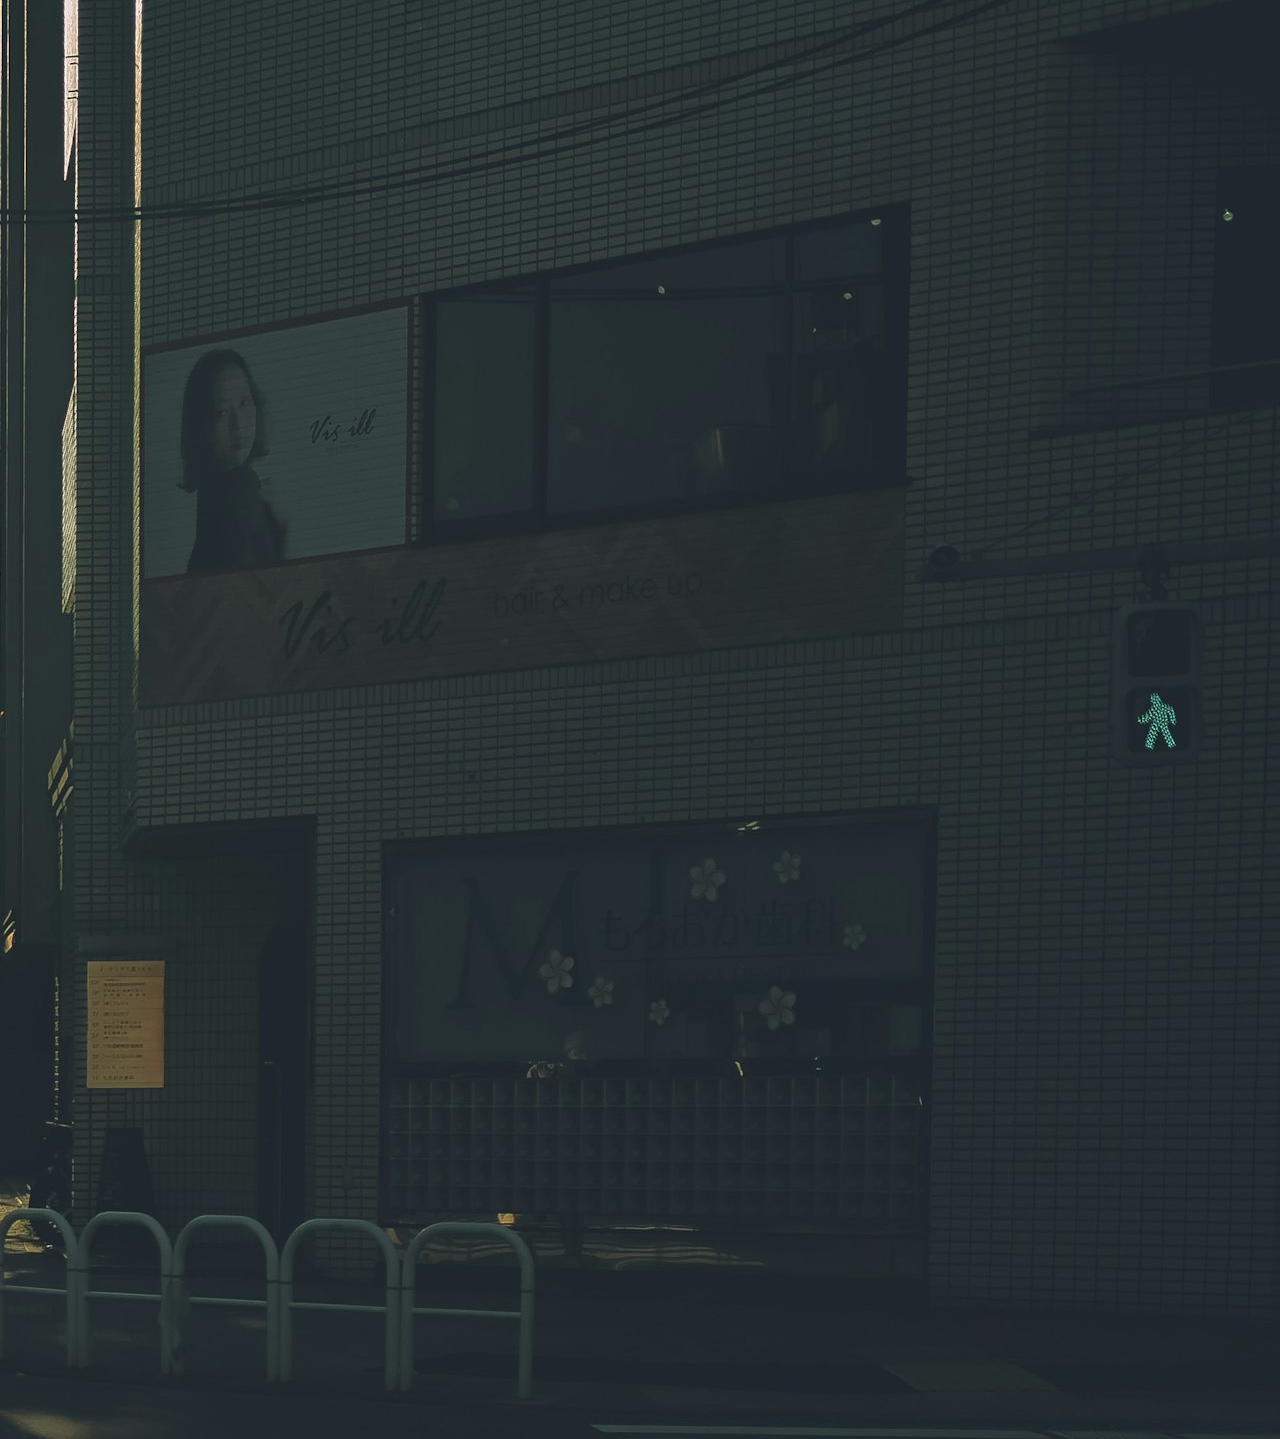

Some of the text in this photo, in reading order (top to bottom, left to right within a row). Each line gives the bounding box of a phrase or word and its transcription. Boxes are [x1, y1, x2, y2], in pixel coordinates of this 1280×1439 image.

[310, 414, 341, 444] Vis
[278, 588, 358, 658] Vis
[493, 588, 542, 618] hair
[551, 583, 570, 611] &
[578, 573, 657, 607] make
[666, 571, 704, 600] up
[446, 867, 592, 1009] M
[598, 896, 839, 953] もろおか歯科
